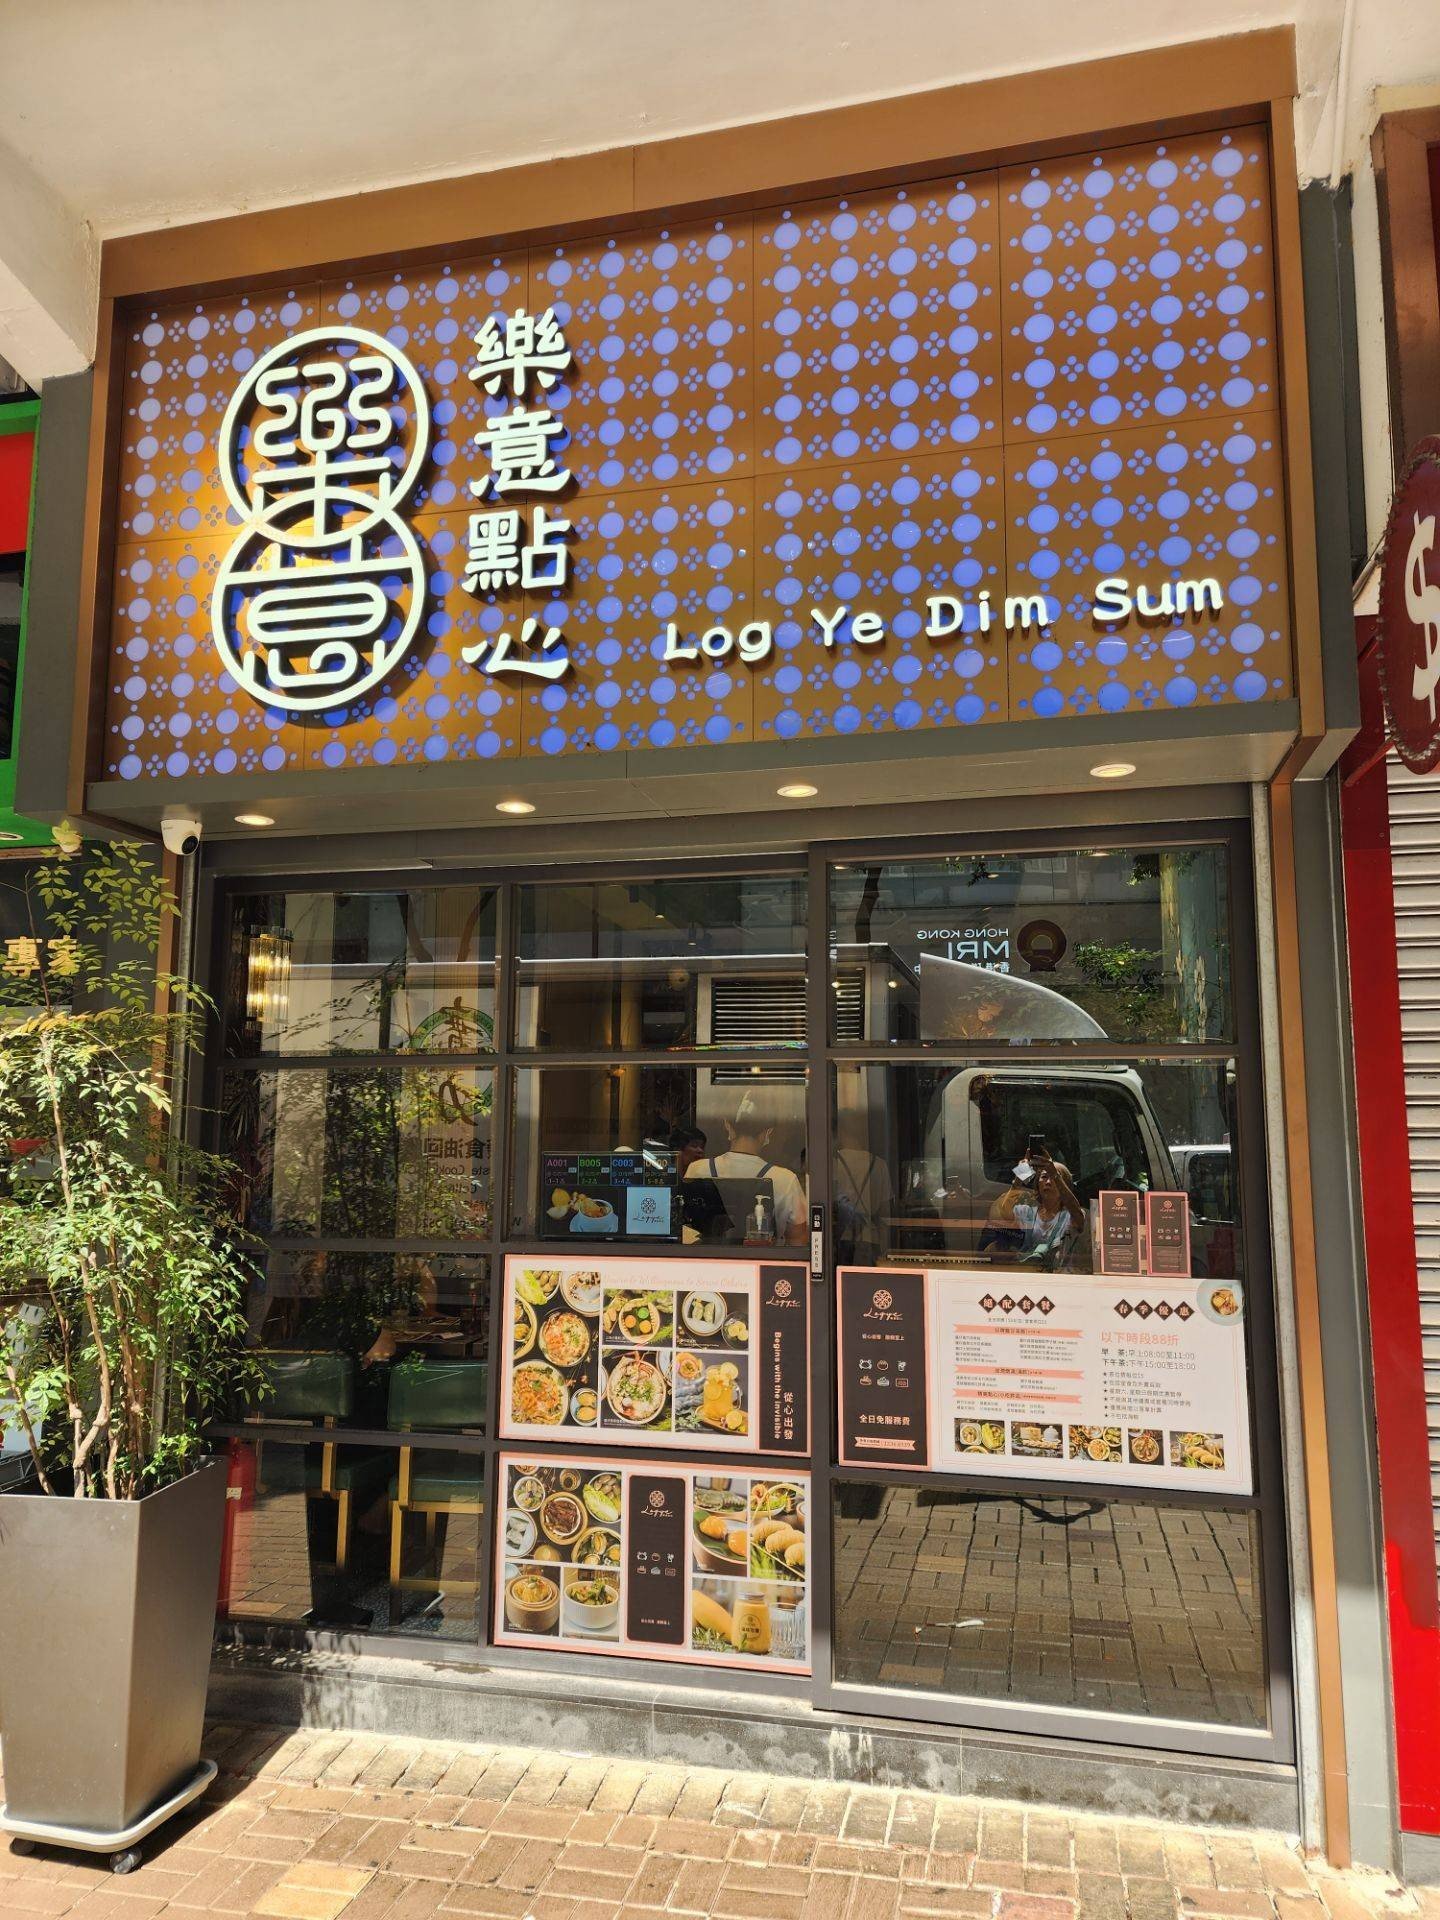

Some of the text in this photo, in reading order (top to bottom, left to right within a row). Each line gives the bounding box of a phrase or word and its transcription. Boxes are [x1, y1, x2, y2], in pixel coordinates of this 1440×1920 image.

[461, 308, 571, 678] 樂意點心
[663, 578, 1223, 662] Log Ye Dim Sum
[1101, 1331, 1180, 1346] 以下時段88折
[773, 1331, 782, 1440] Begins with the invisible
[859, 1414, 911, 1426] 全日免服務費
